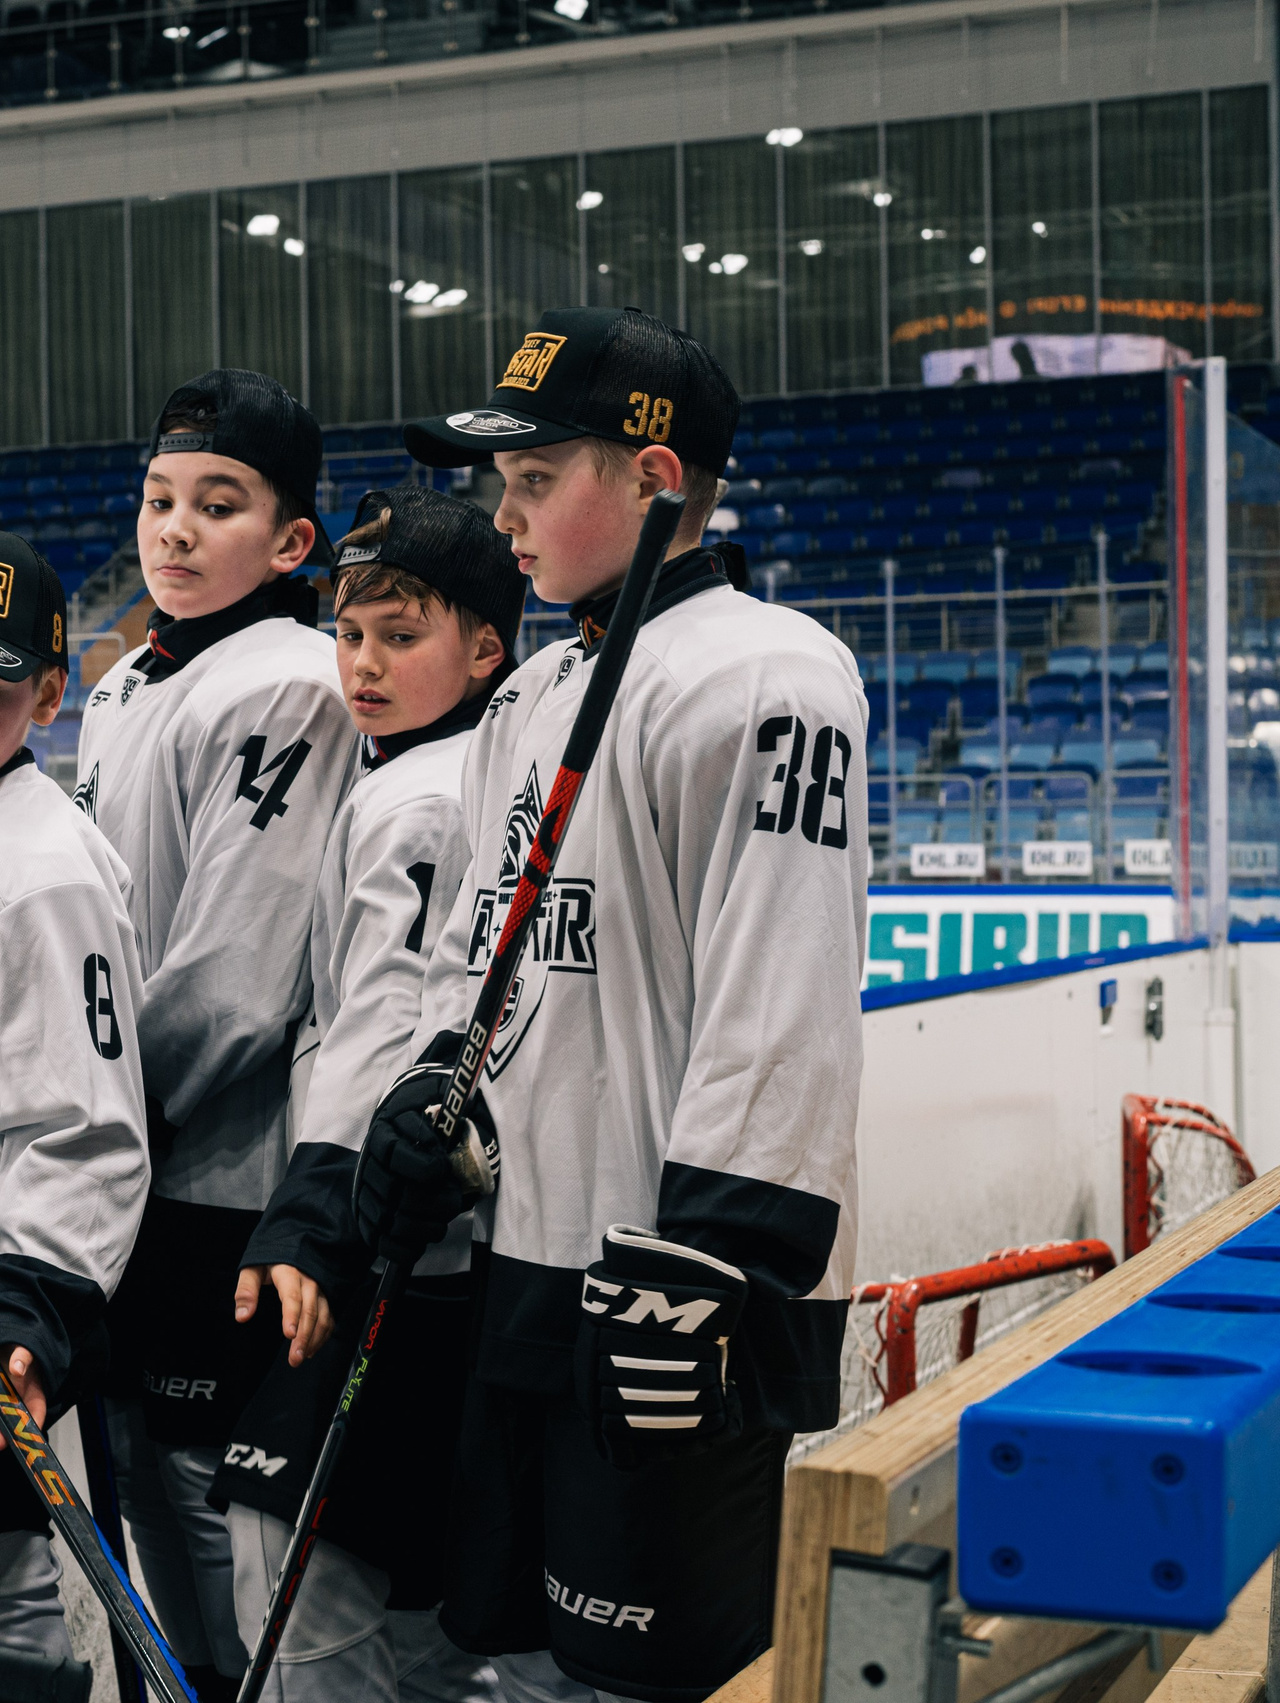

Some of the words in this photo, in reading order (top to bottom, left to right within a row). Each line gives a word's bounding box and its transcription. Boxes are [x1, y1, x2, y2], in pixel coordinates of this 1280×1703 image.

[623, 391, 674, 443] 38
[52, 611, 63, 654] 8
[235, 734, 313, 832] 14
[753, 715, 852, 850] 38
[404, 861, 436, 954] 1
[83, 953, 123, 1060] 8
[438, 1020, 488, 1138] BAUER
[365, 1299, 388, 1351] VAPOR
[340, 1356, 370, 1412] FLYLITE
[225, 1442, 288, 1478] CM
[544, 1566, 656, 1632] AUER
